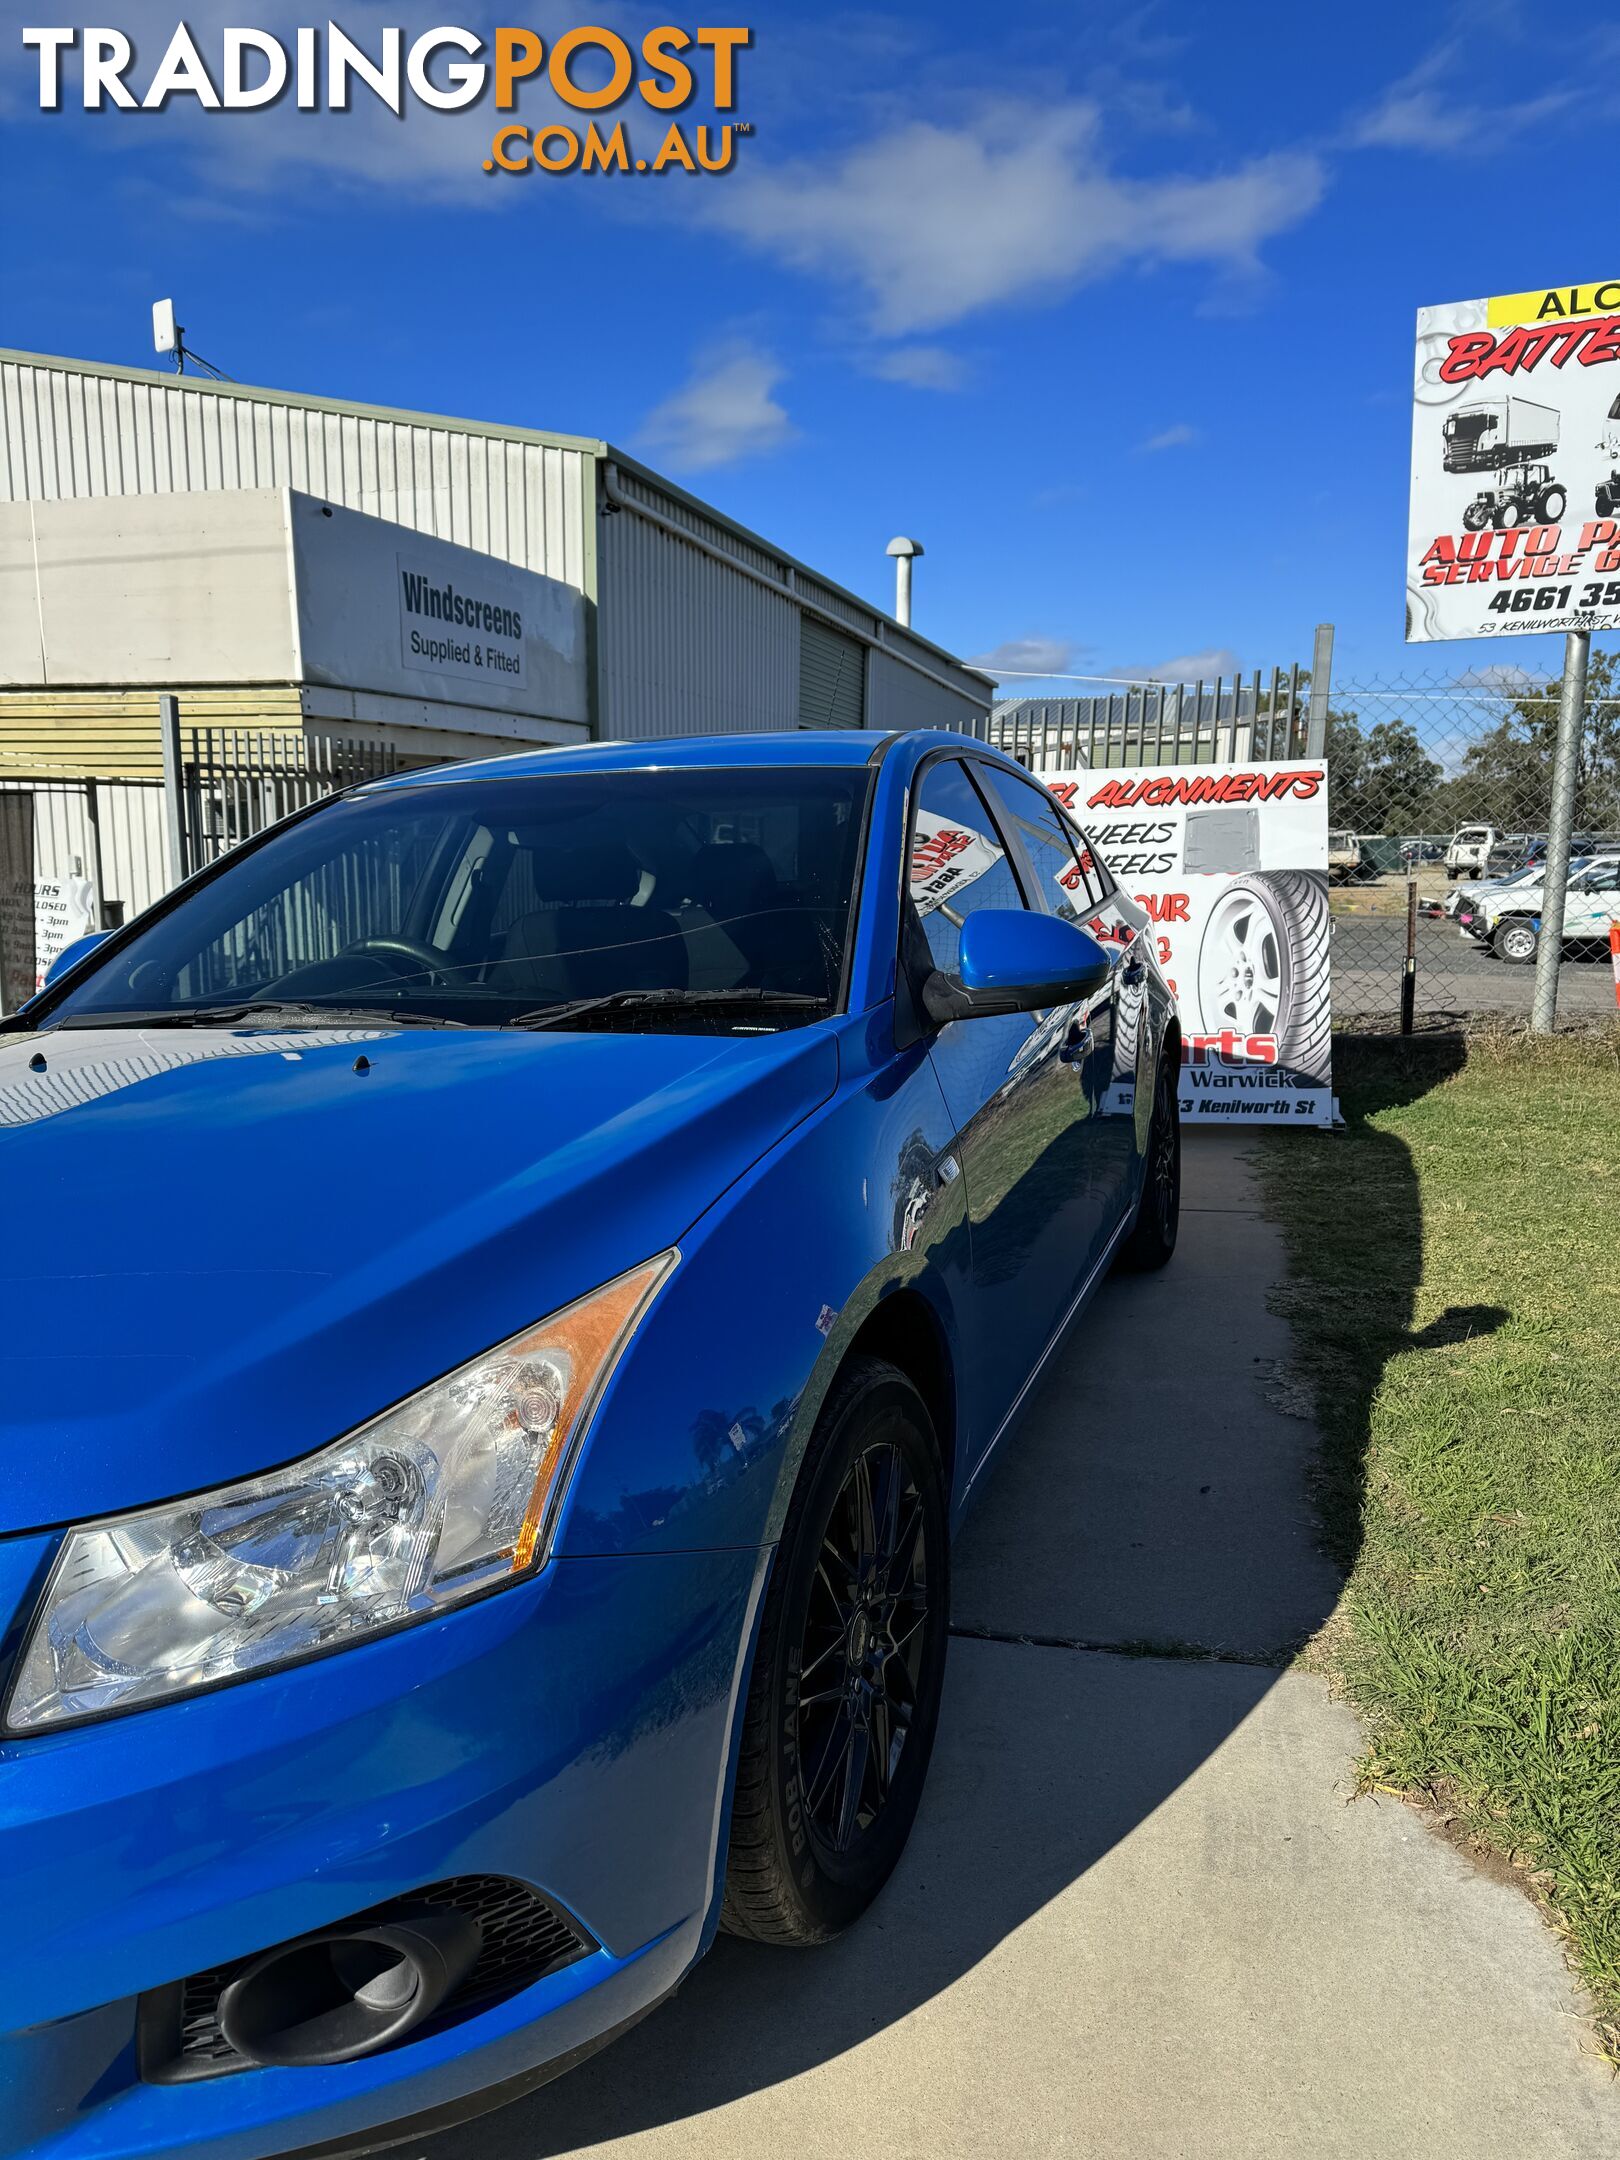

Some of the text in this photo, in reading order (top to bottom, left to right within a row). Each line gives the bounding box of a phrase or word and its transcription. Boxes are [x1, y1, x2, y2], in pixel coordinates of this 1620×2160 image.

[1439, 315, 1620, 384] BATTE
[1418, 524, 1562, 566] AUTO
[1420, 553, 1586, 587] SERVICE
[402, 570, 522, 640] Windscreens
[1488, 585, 1572, 613] 4661
[1477, 622, 1496, 633] 53
[1500, 616, 1591, 631] KENILWORTH
[410, 630, 520, 674] Supplied & Fitted
[1086, 771, 1325, 810] ALIGNMENTS
[42, 929, 63, 939] 3pm
[47, 916, 69, 926] 3pm
[1191, 1071, 1296, 1089] Warwick
[1198, 1099, 1291, 1114] Kenilworth
[1295, 1100, 1315, 1114] St
